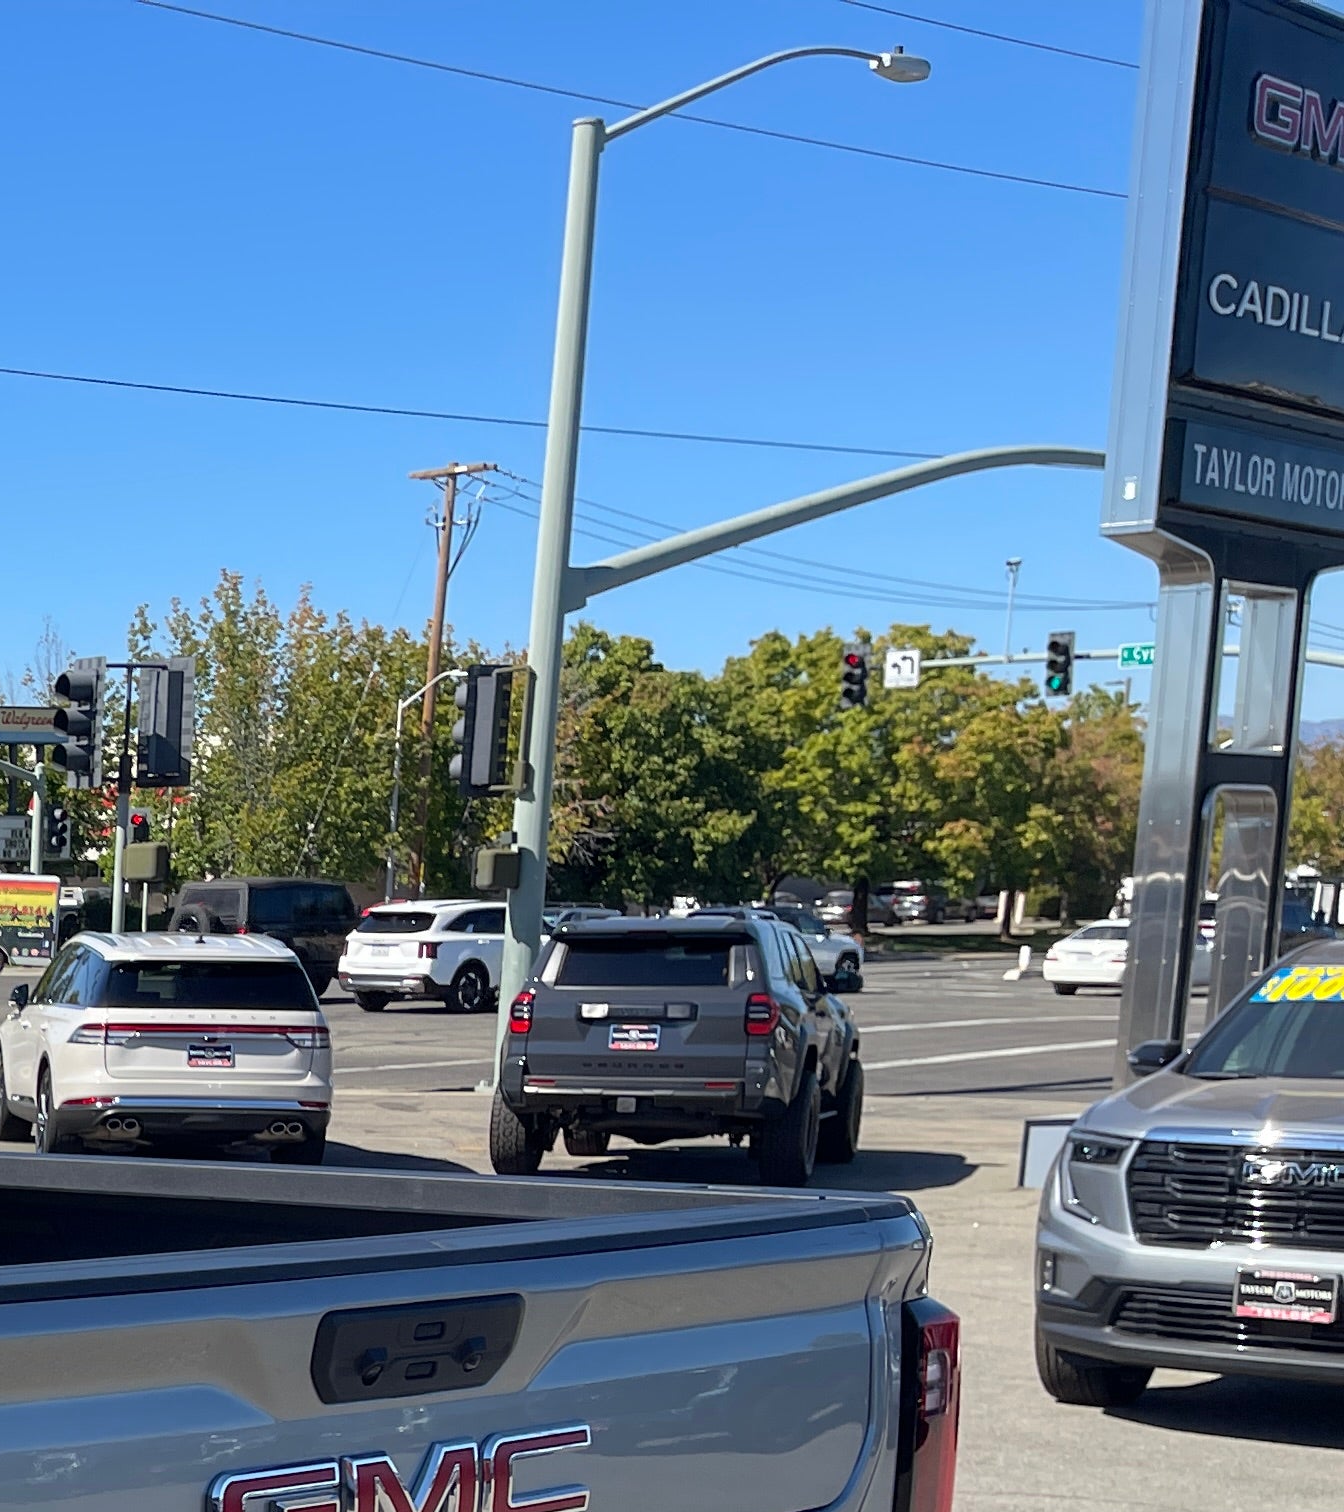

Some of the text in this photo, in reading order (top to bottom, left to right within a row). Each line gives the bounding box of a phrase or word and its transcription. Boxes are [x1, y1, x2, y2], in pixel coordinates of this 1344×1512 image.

[1209, 273, 1344, 344] CADILL
[1194, 443, 1276, 497] TAYLOR
[1, 710, 54, 730] Walgreen
